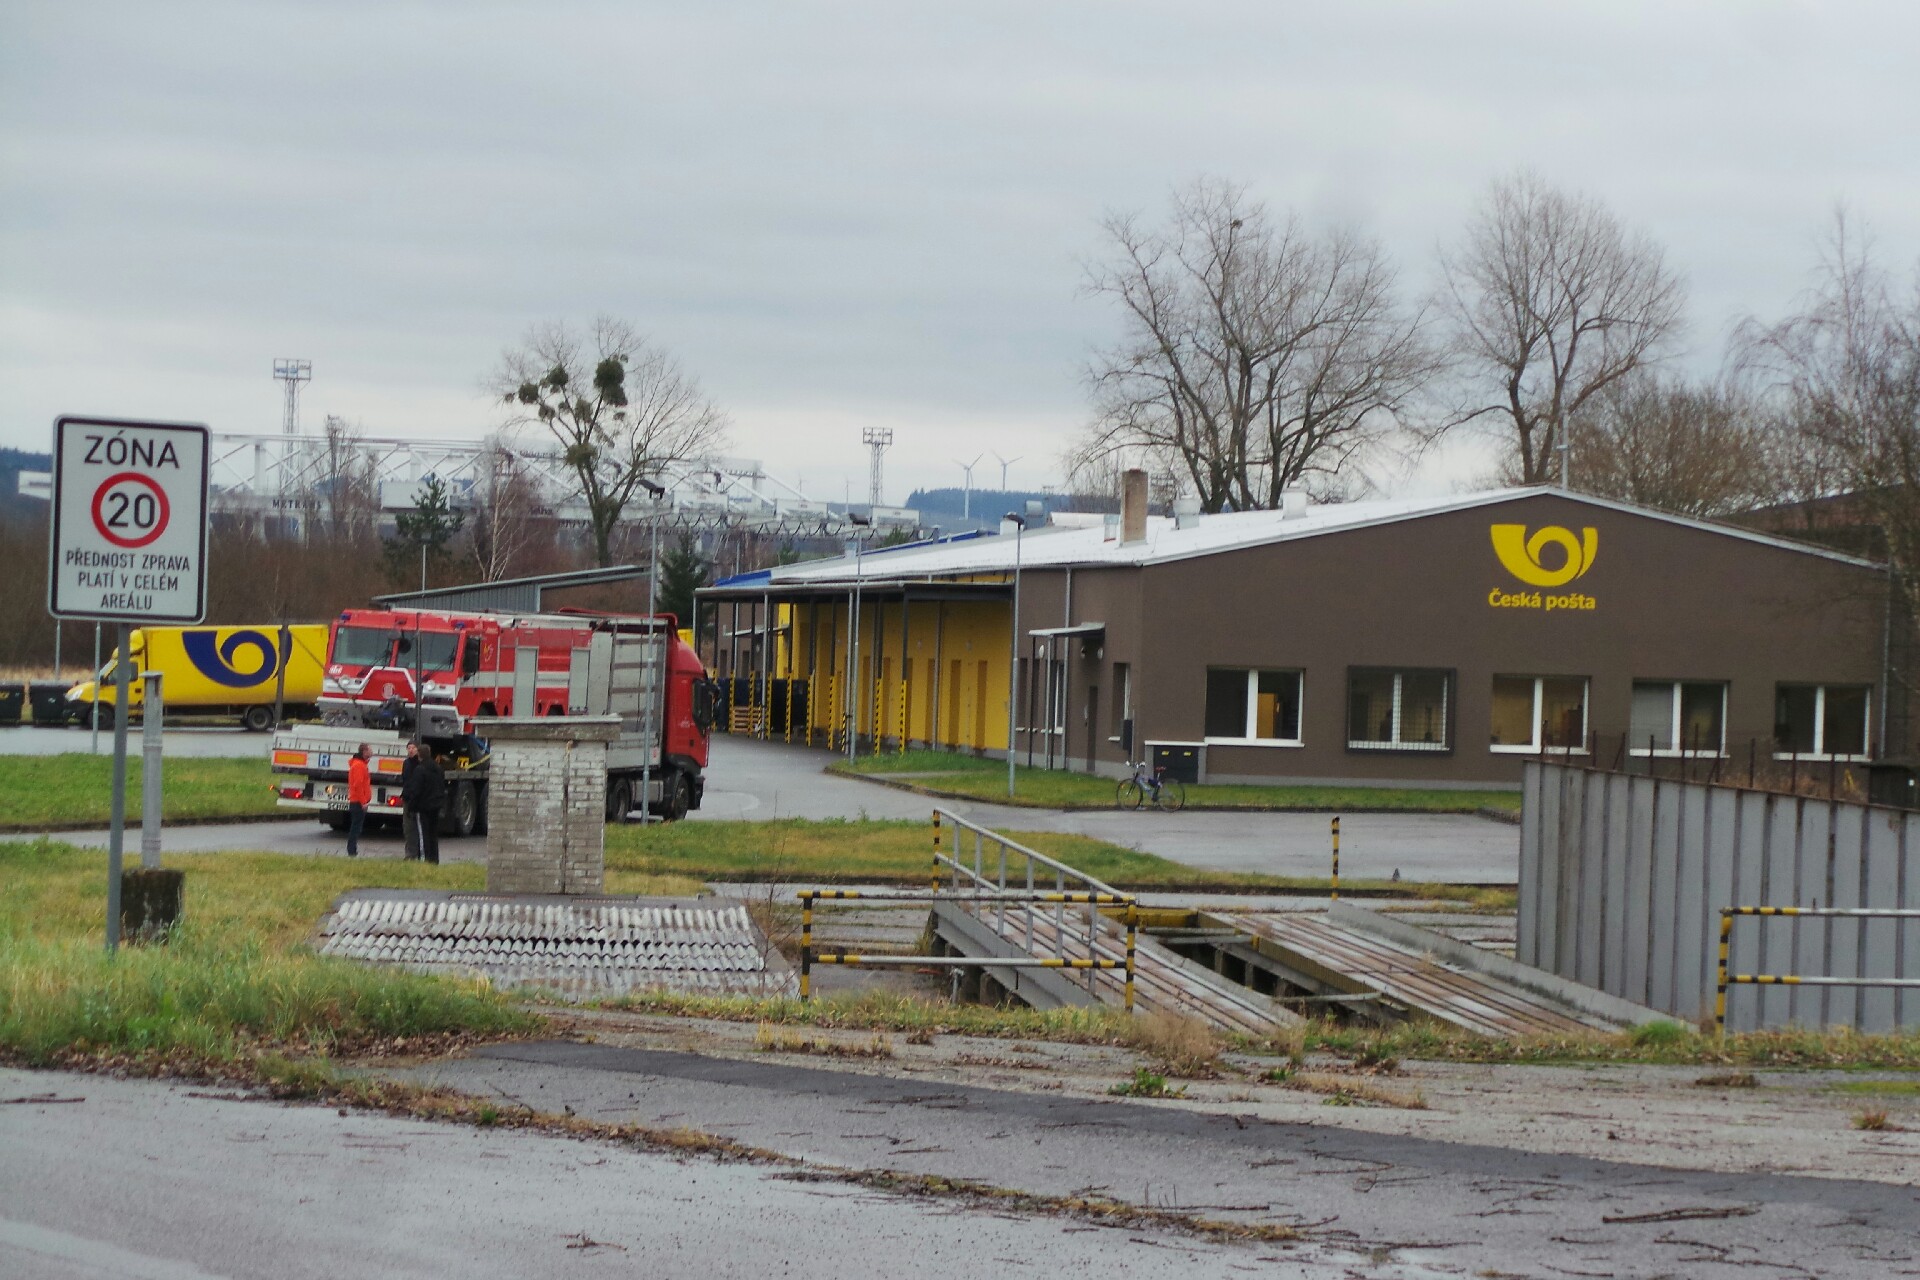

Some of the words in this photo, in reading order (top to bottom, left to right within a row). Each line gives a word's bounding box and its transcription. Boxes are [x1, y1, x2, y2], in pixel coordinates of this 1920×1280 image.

[84, 429, 180, 469] ZÓNA
[107, 492, 155, 528] 20
[66, 548, 135, 569] PŘEDNOST
[142, 554, 190, 571] ZPRAVA
[78, 570, 114, 588] PLATÍ
[121, 573, 129, 589] V
[134, 572, 178, 590] CELÉM
[100, 592, 153, 610] AREÁLU
[1488, 587, 1541, 608] Česká
[1545, 593, 1596, 611] pošta
